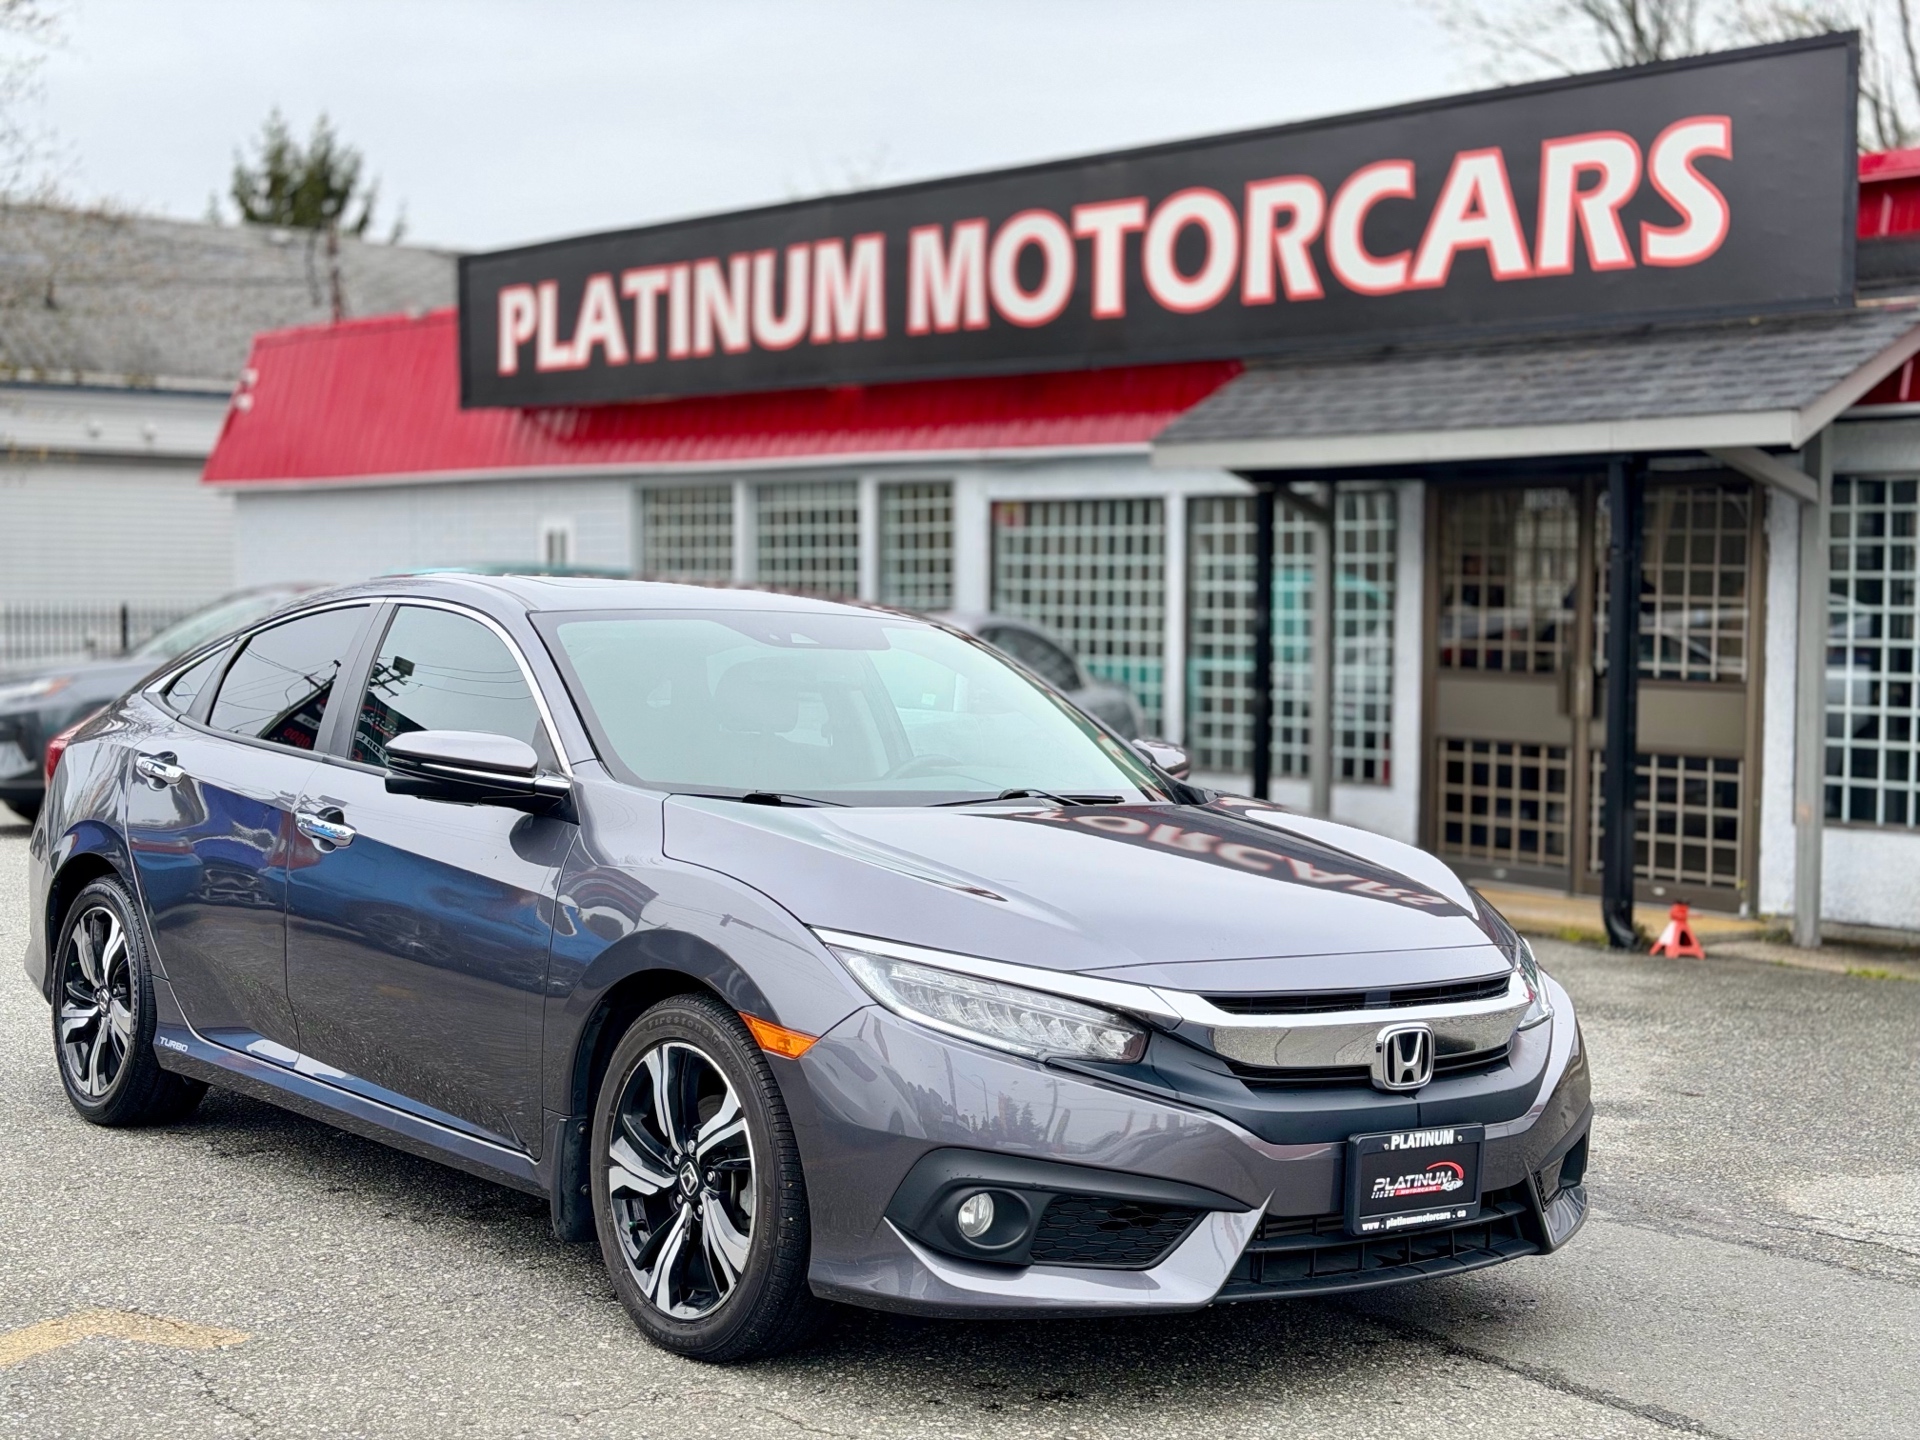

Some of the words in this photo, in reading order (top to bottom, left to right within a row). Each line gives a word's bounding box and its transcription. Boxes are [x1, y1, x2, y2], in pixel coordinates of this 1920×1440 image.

[499, 232, 886, 376] PLATINUM
[906, 113, 1734, 335] MOTORCARS
[160, 1036, 189, 1053] TURBO
[1390, 1129, 1455, 1151] PLATINUM
[1373, 1170, 1452, 1192] PLATINUM
